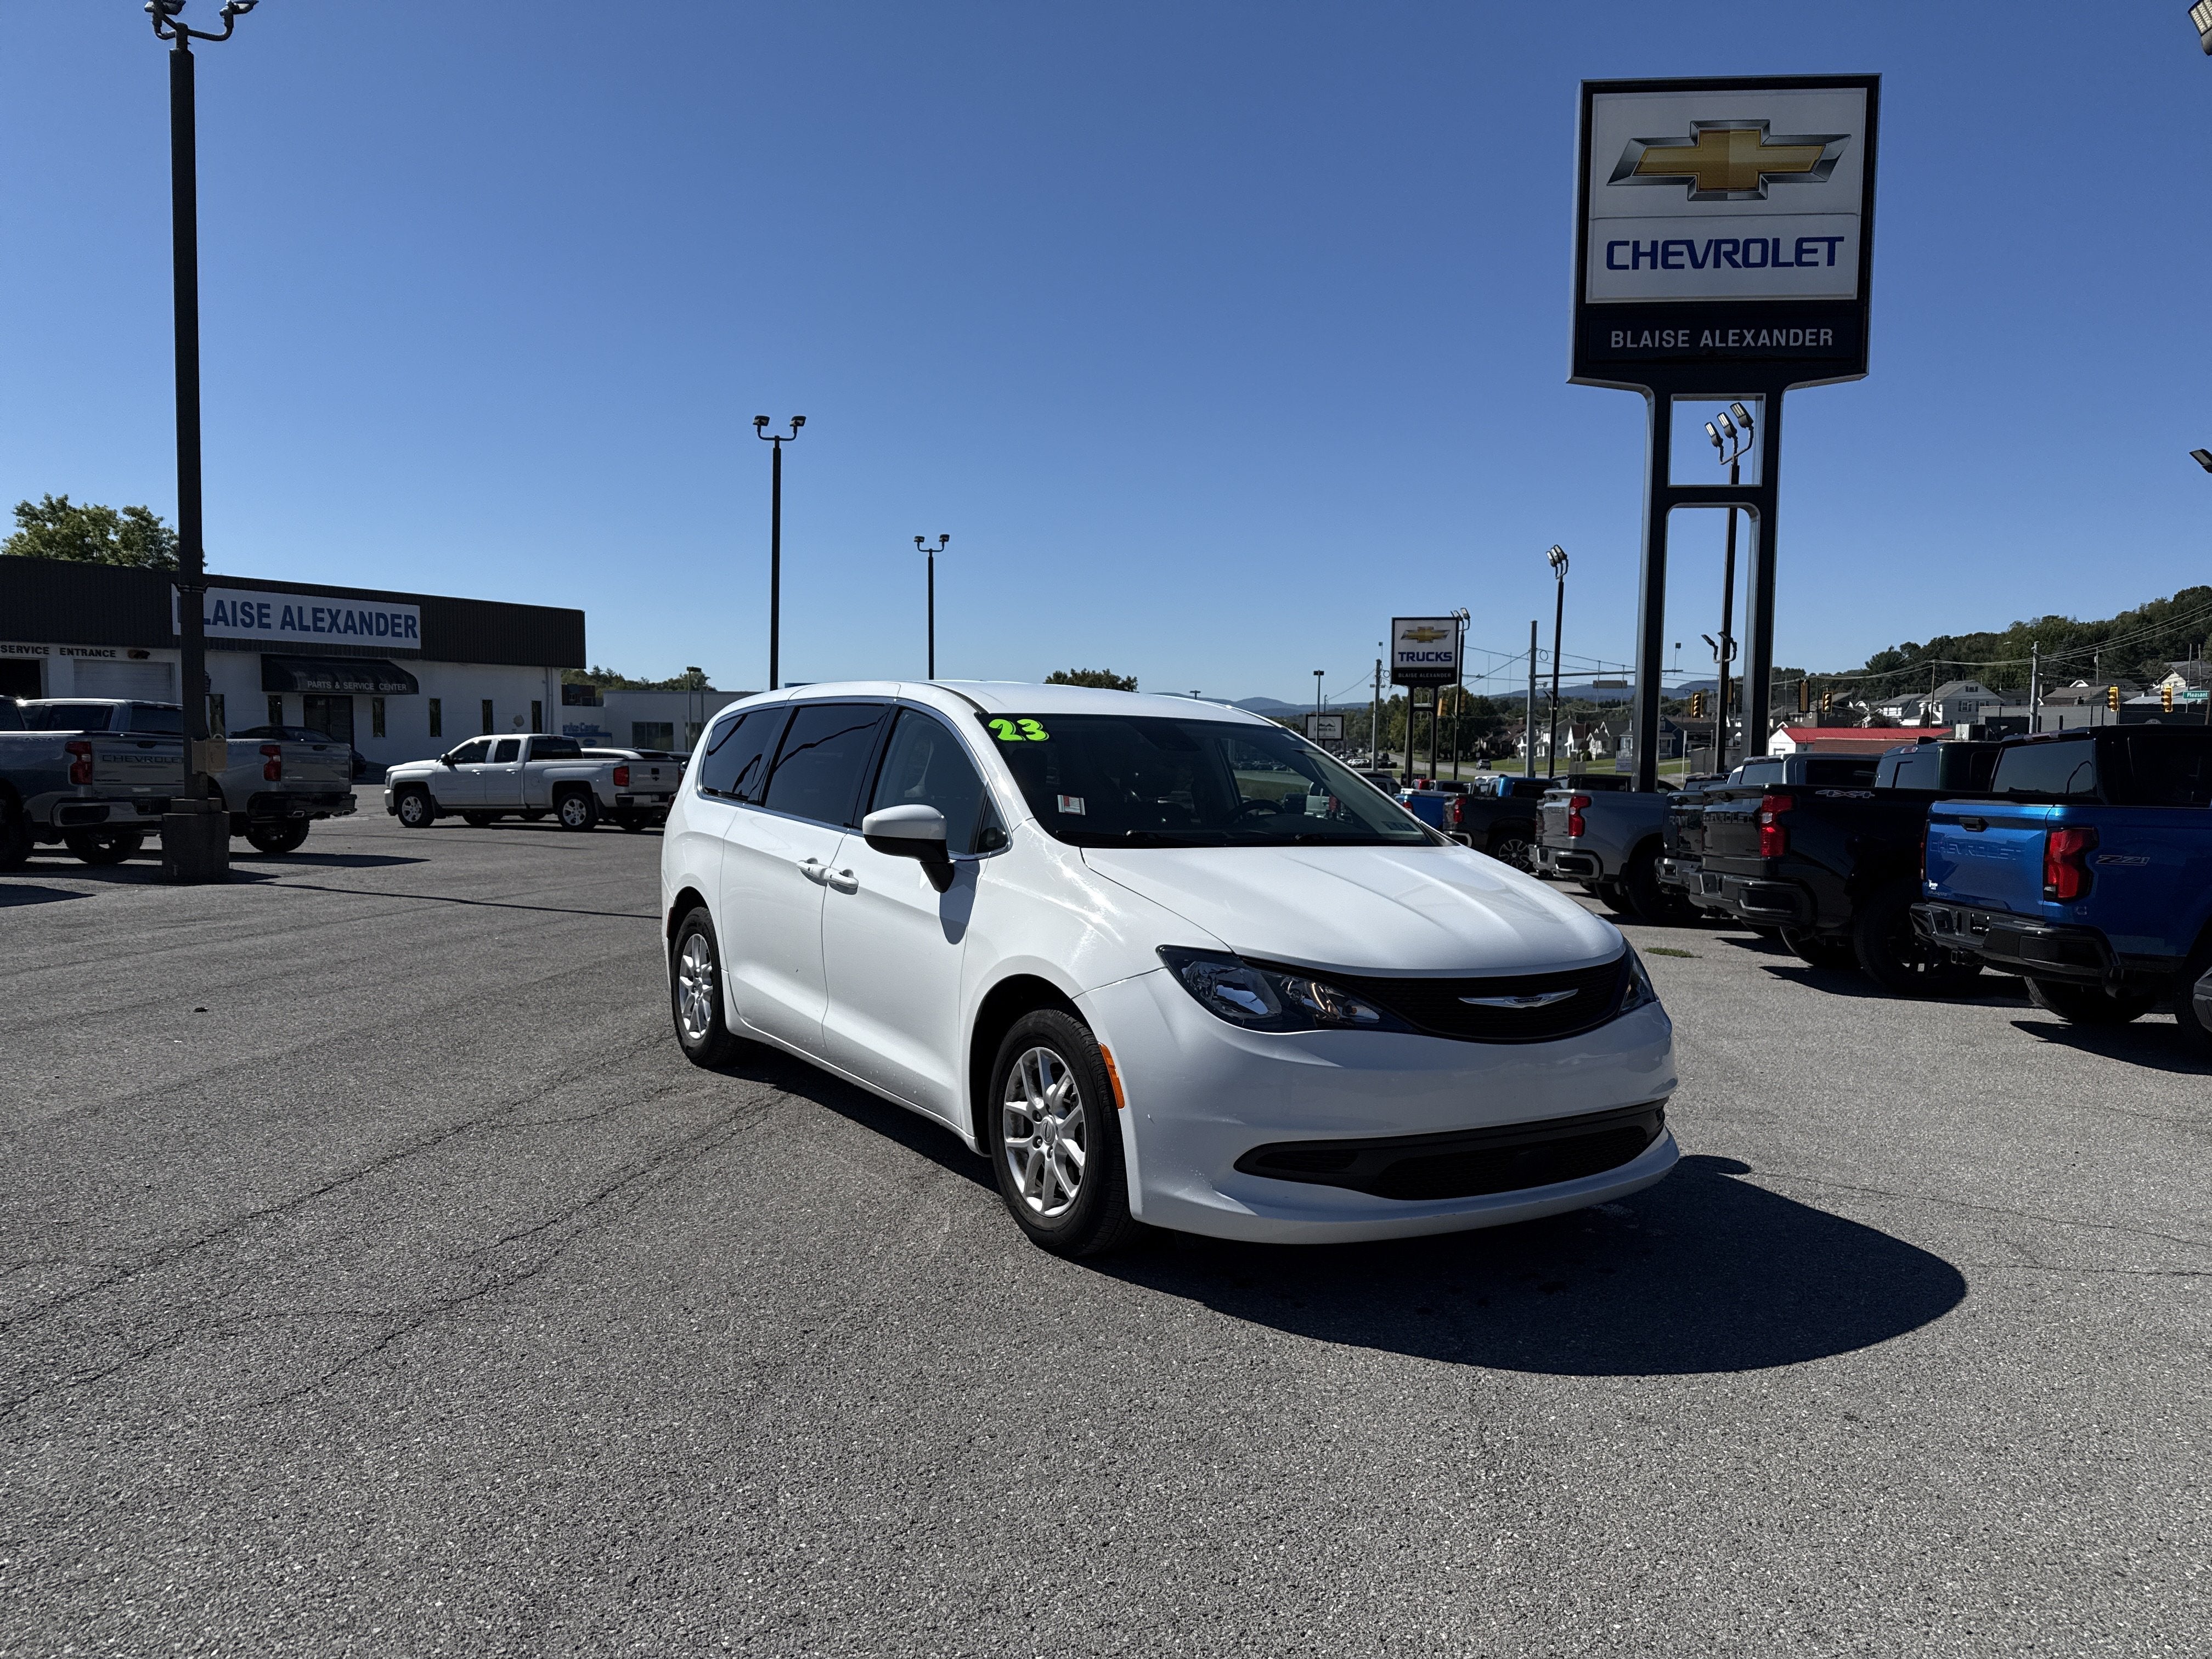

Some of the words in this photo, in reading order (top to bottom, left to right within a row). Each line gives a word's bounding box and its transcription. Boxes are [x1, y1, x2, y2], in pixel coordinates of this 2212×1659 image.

[1606, 236, 1844, 270] CHEVROLET
[1611, 330, 1690, 348] BLAISE
[1700, 329, 1833, 347] ALEXANDER
[177, 596, 271, 629] AISE
[280, 605, 418, 639] ALEXANDER
[1, 645, 50, 654] SERVICE
[59, 647, 116, 658] ENTRANCE
[1398, 652, 1452, 662] TRUCKS
[307, 680, 331, 689] PARTS
[335, 681, 340, 689] &
[343, 681, 374, 690] SERVICE
[379, 682, 407, 691] CENTER
[988, 719, 1050, 741] 23
[1668, 815, 1688, 826] RAM
